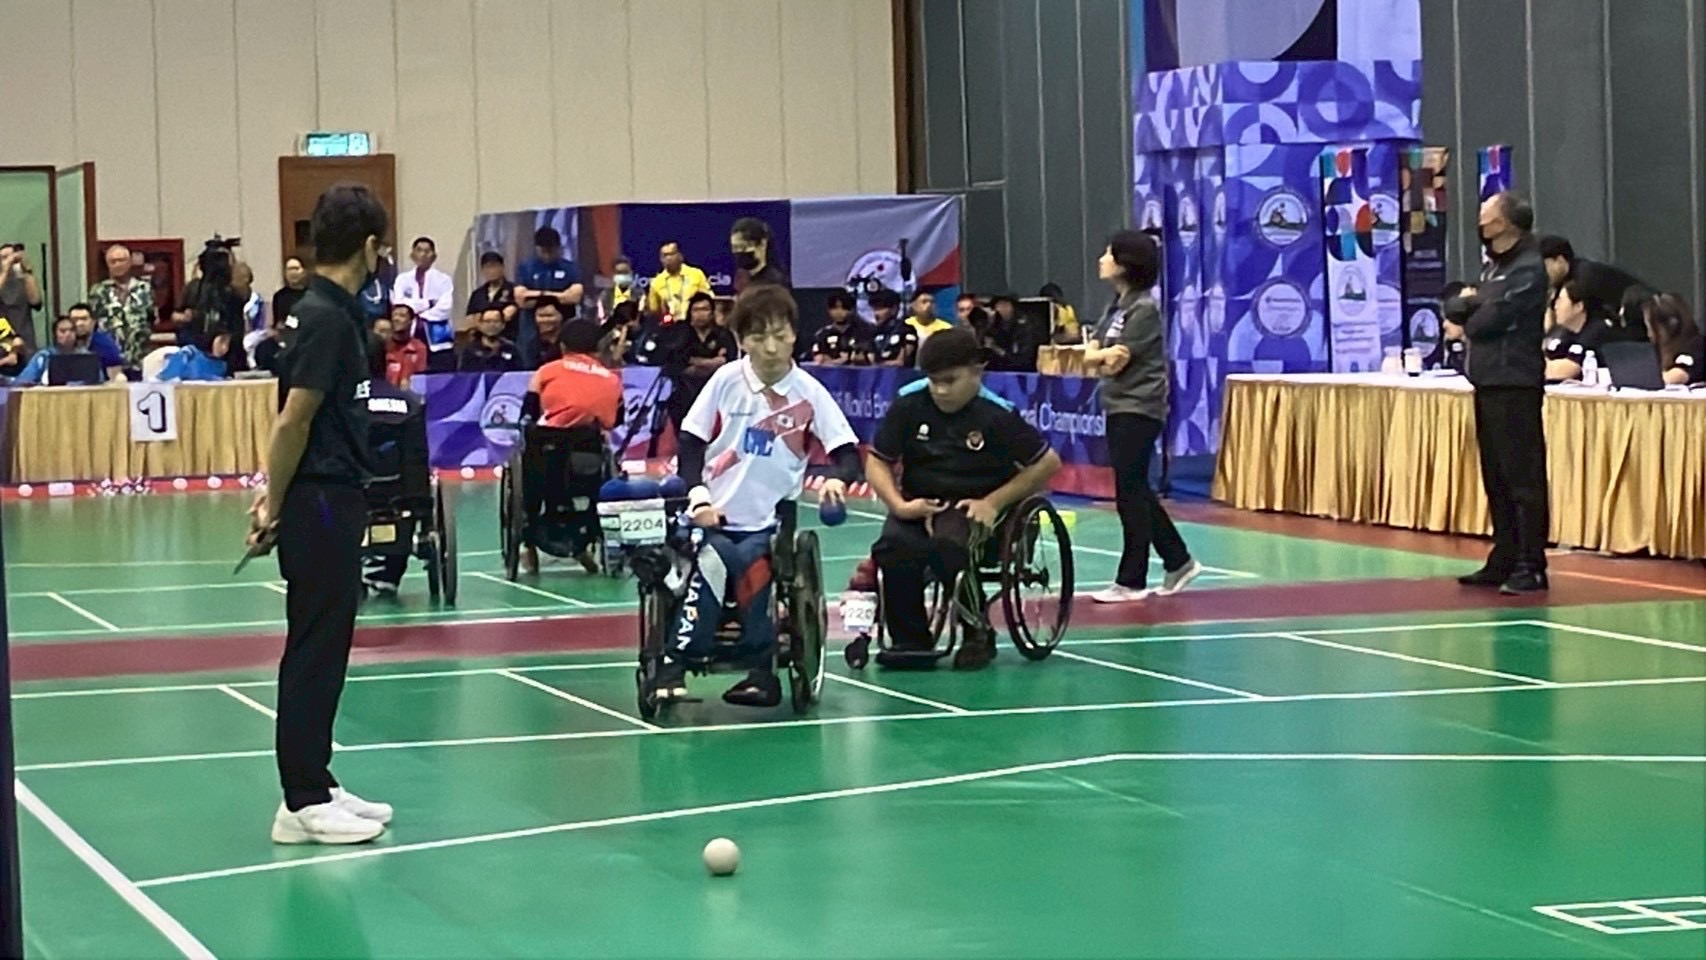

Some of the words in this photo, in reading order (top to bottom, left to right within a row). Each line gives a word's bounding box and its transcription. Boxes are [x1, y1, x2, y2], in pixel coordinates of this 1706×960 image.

[137, 391, 167, 433] 1
[622, 518, 664, 532] 2204
[675, 571, 702, 651] JAPAN
